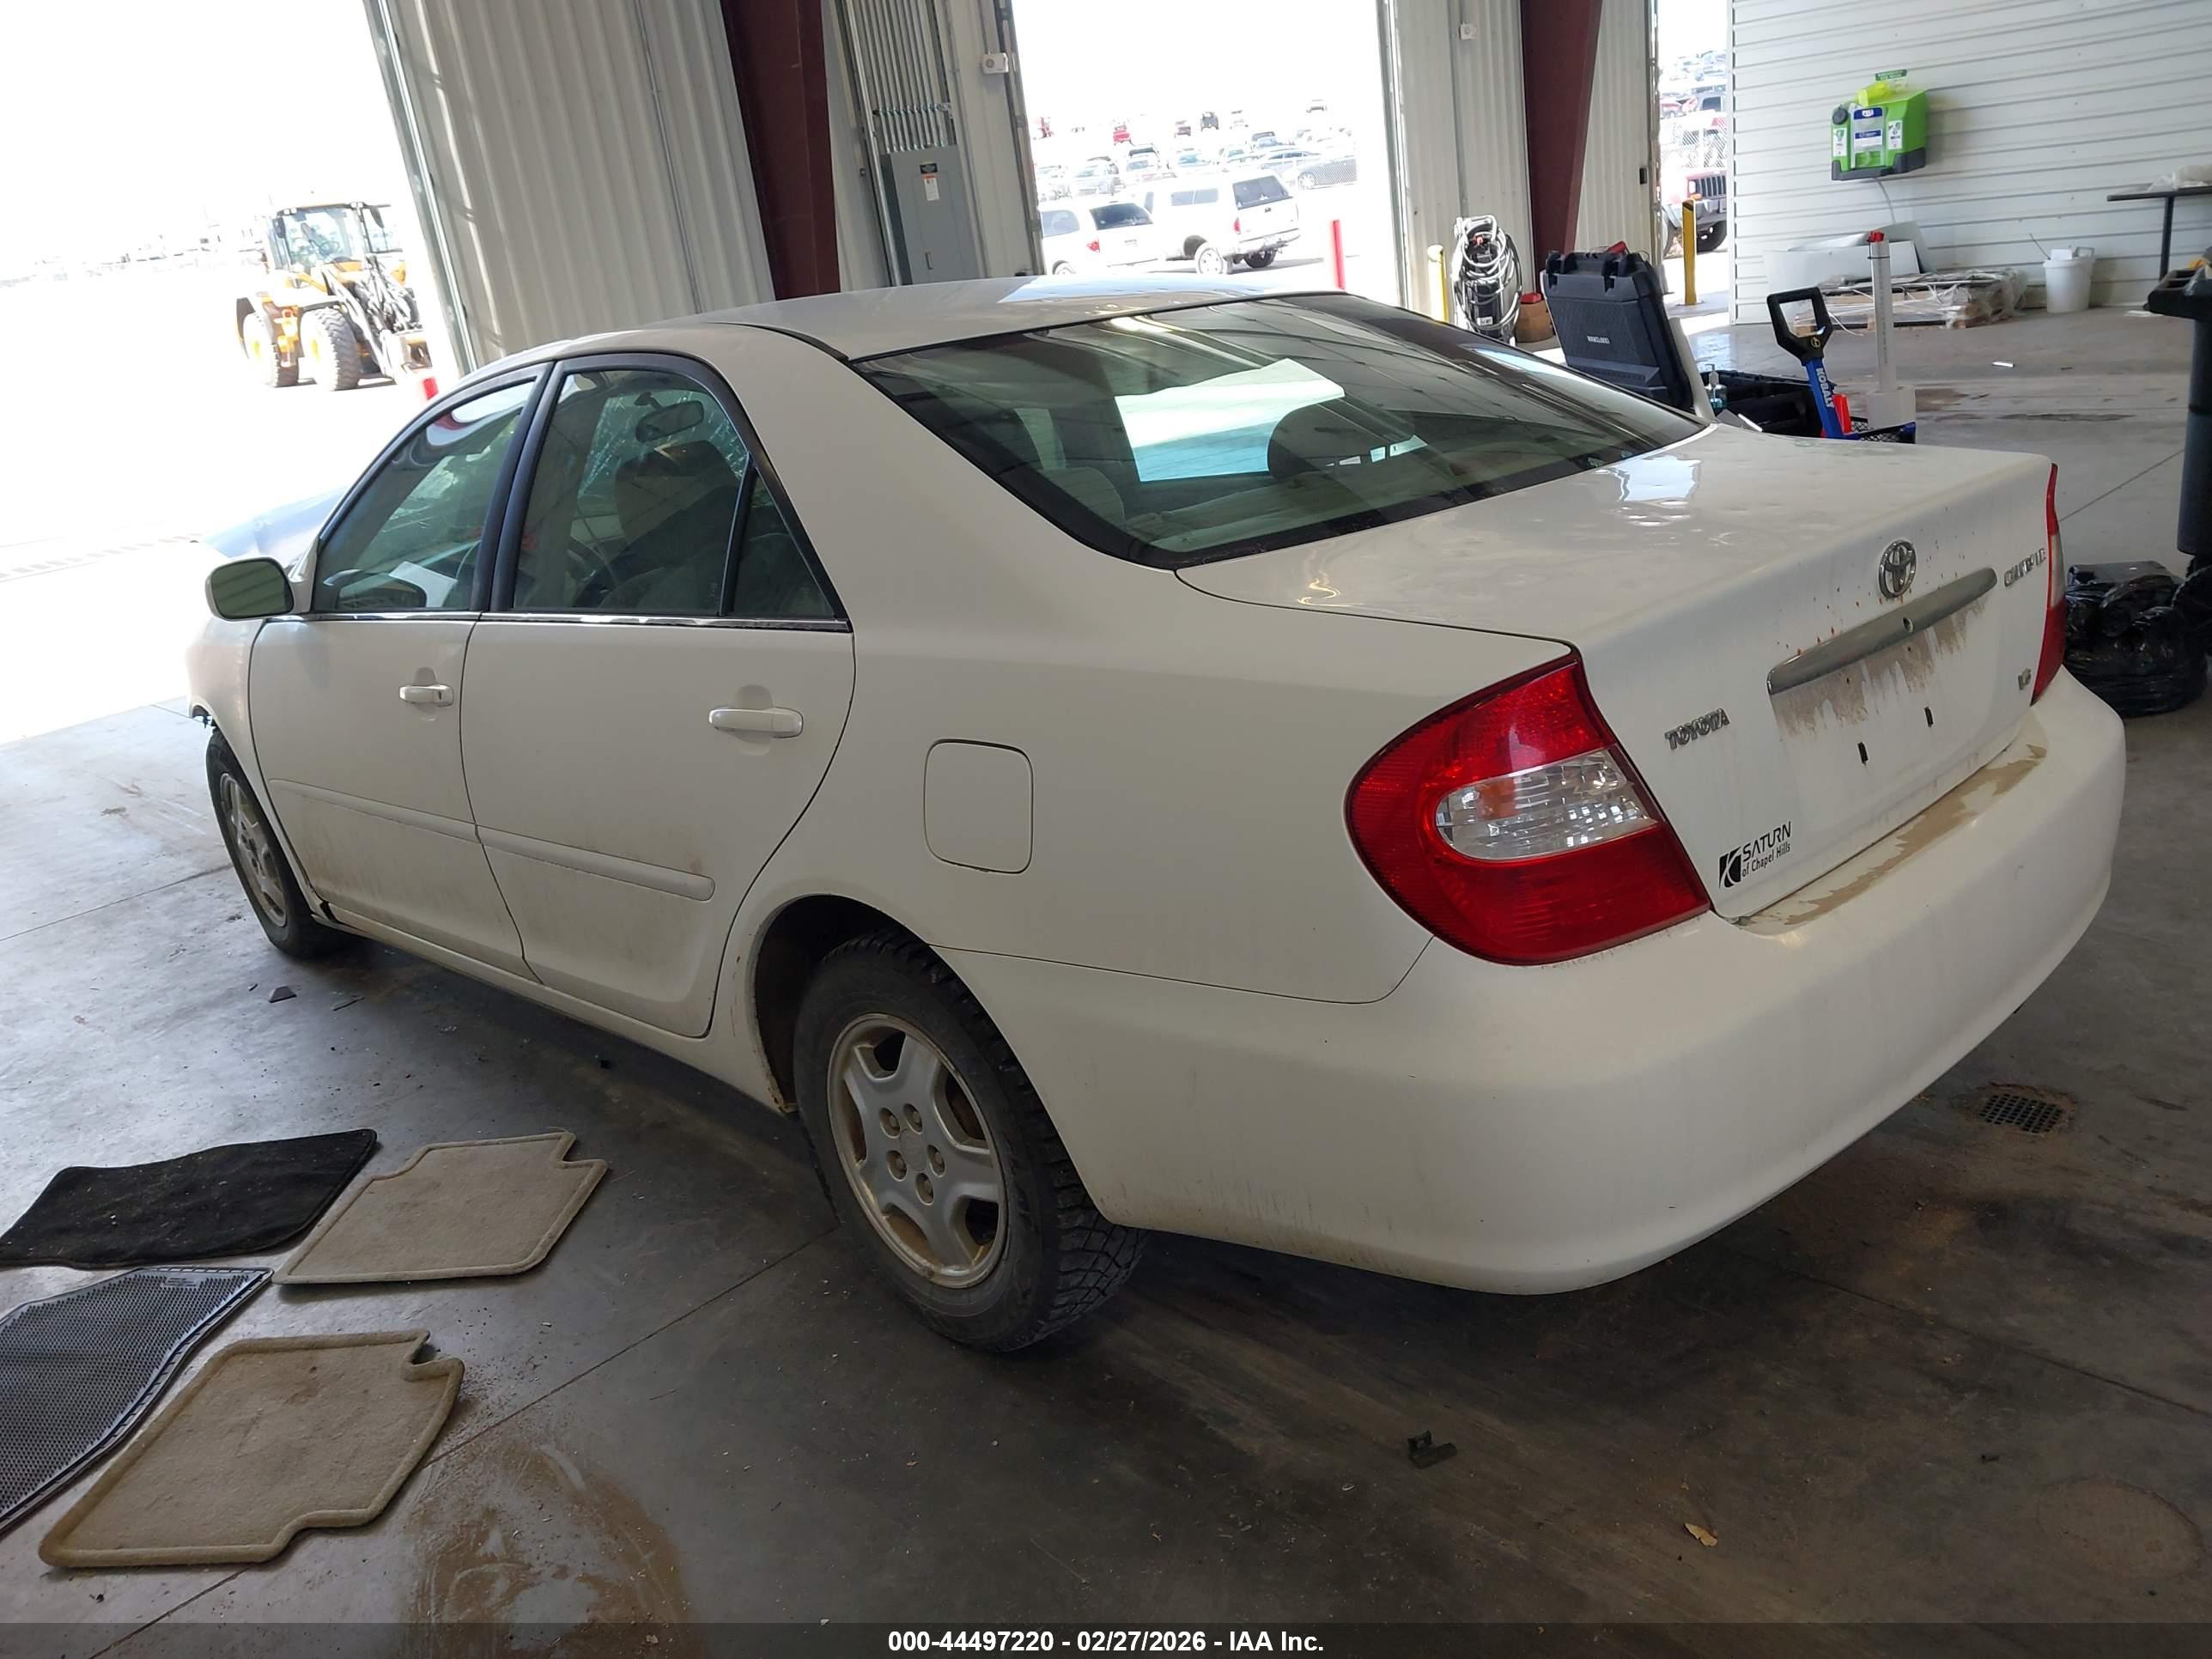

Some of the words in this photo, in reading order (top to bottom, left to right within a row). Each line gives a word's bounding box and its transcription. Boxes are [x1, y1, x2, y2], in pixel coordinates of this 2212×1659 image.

[1815, 368, 1835, 408] KOBALT
[1664, 708, 1730, 750] TOYOTA
[1742, 821, 1791, 862] SATURN
[1742, 861, 1750, 878] of
[1752, 848, 1774, 872] Chapel
